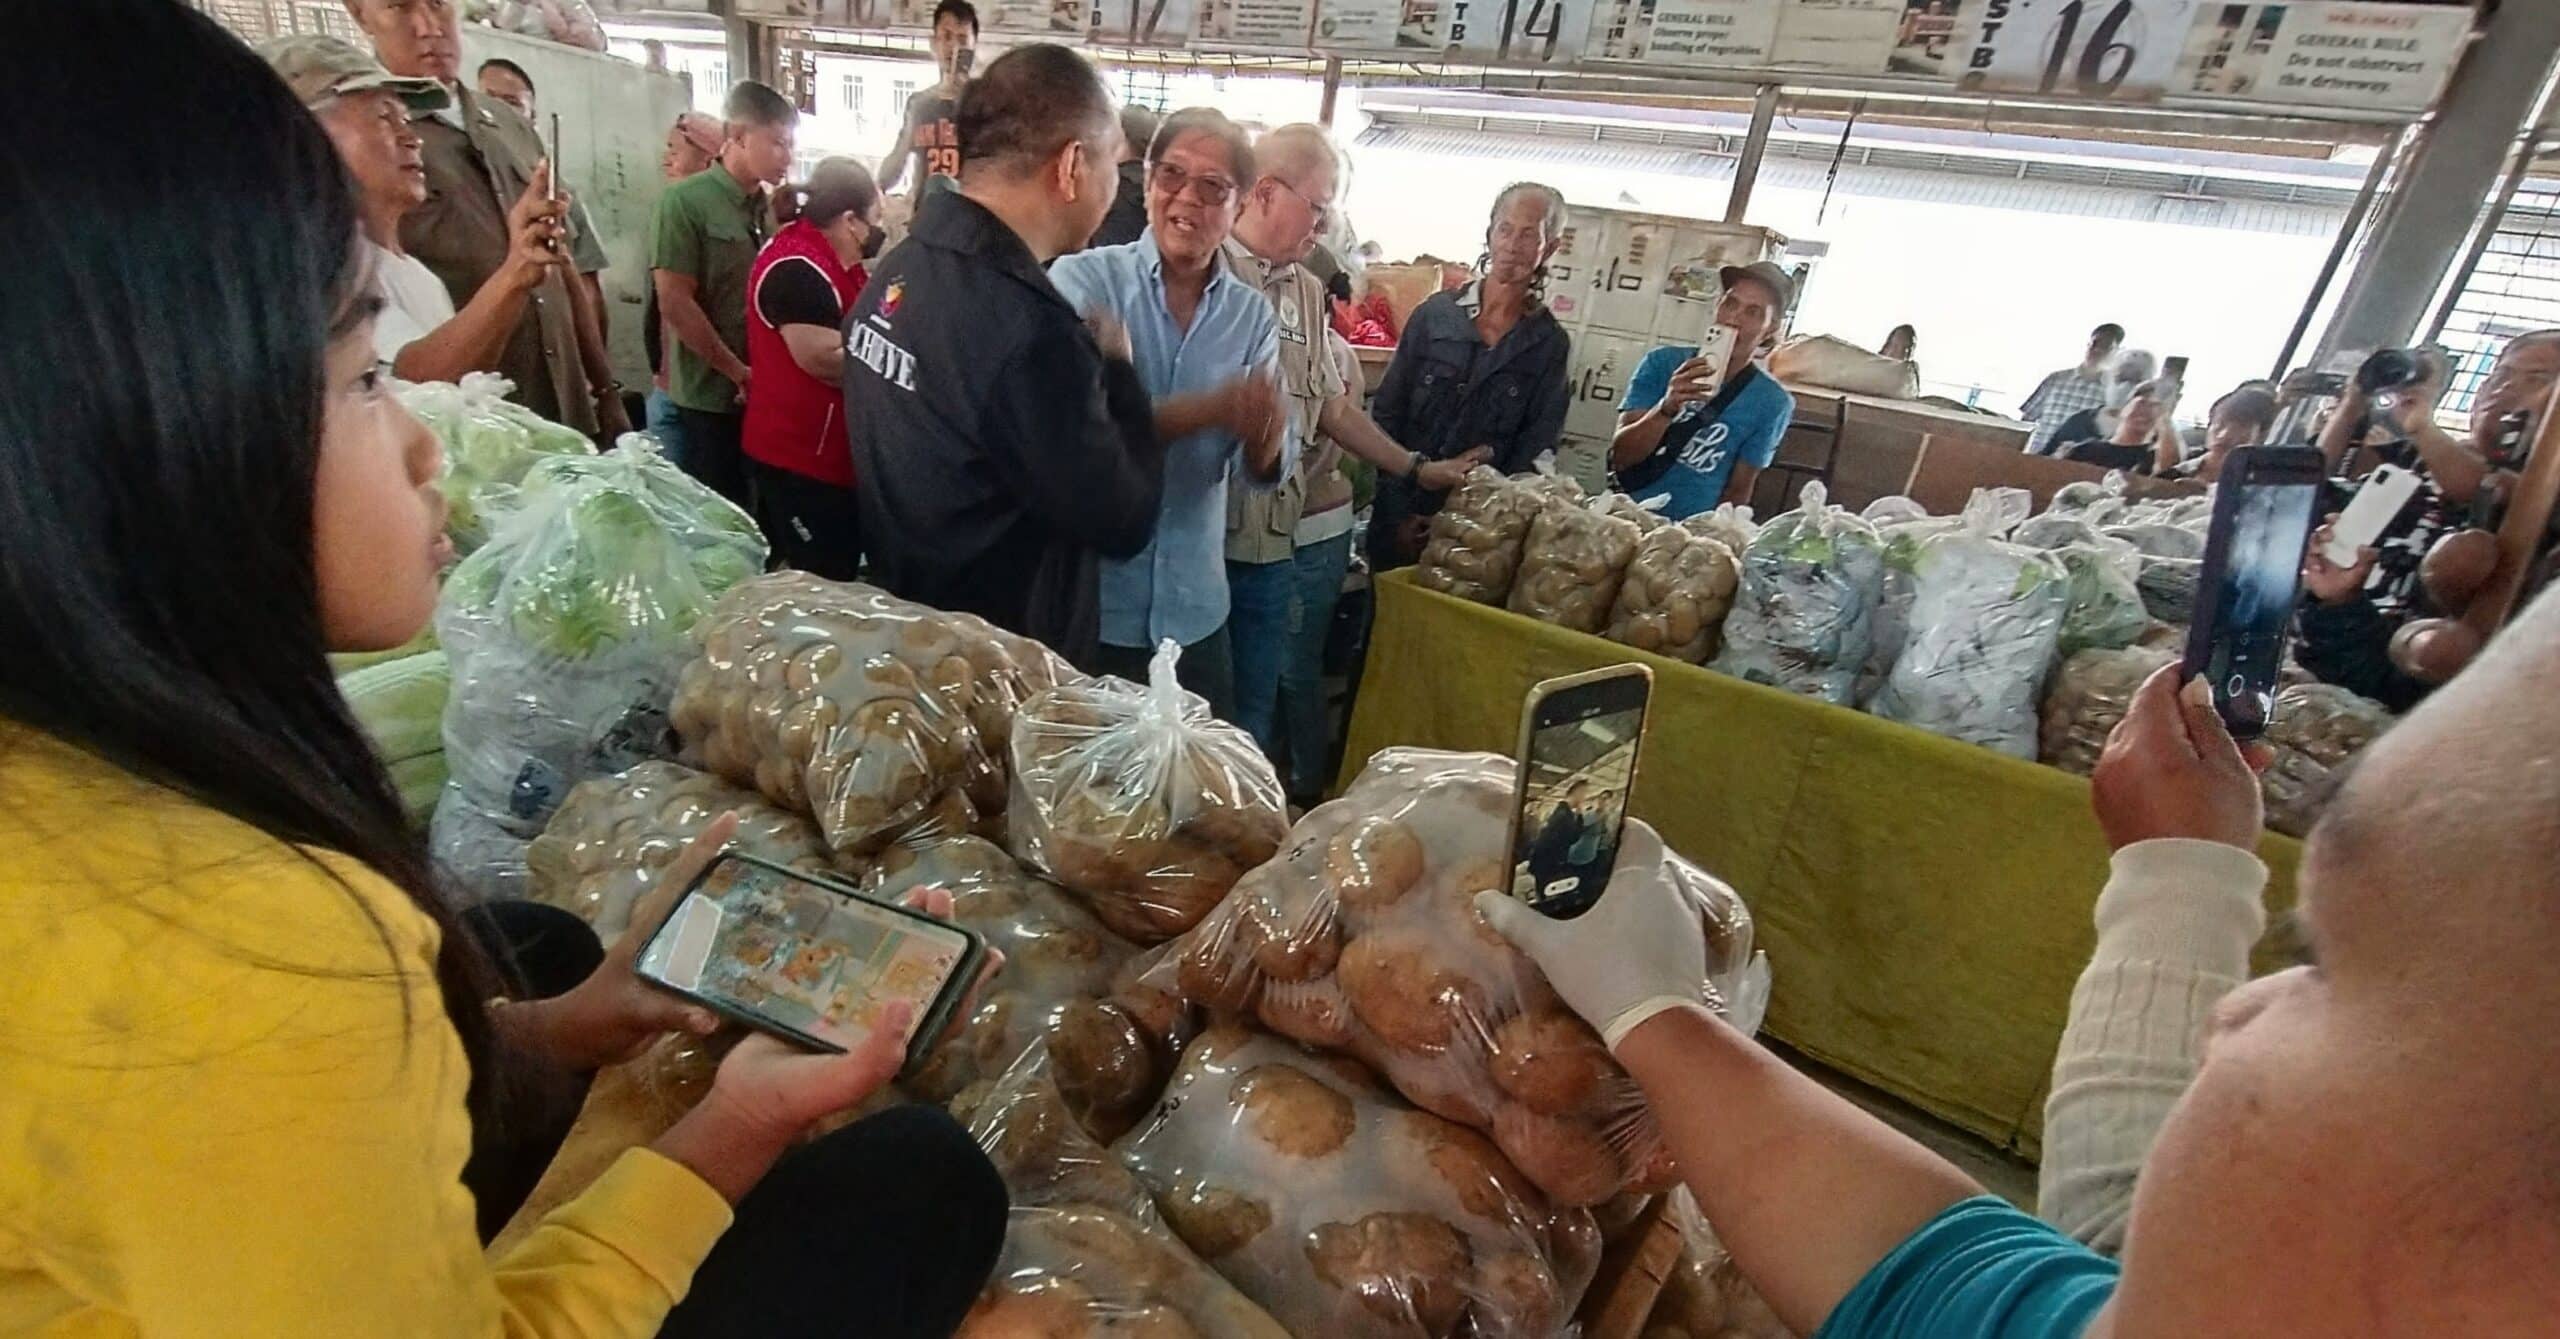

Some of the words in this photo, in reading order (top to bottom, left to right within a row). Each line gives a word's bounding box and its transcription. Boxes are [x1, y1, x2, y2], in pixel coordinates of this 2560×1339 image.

[1499, 0, 1562, 62] 14
[2295, 33, 2368, 49] GENERAL
[2038, 0, 2136, 97] 16
[2287, 52, 2311, 66] Do
[2315, 56, 2347, 68] not
[2347, 56, 2424, 73] obstruct
[2277, 73, 2308, 87] the
[927, 148, 959, 177] 29
